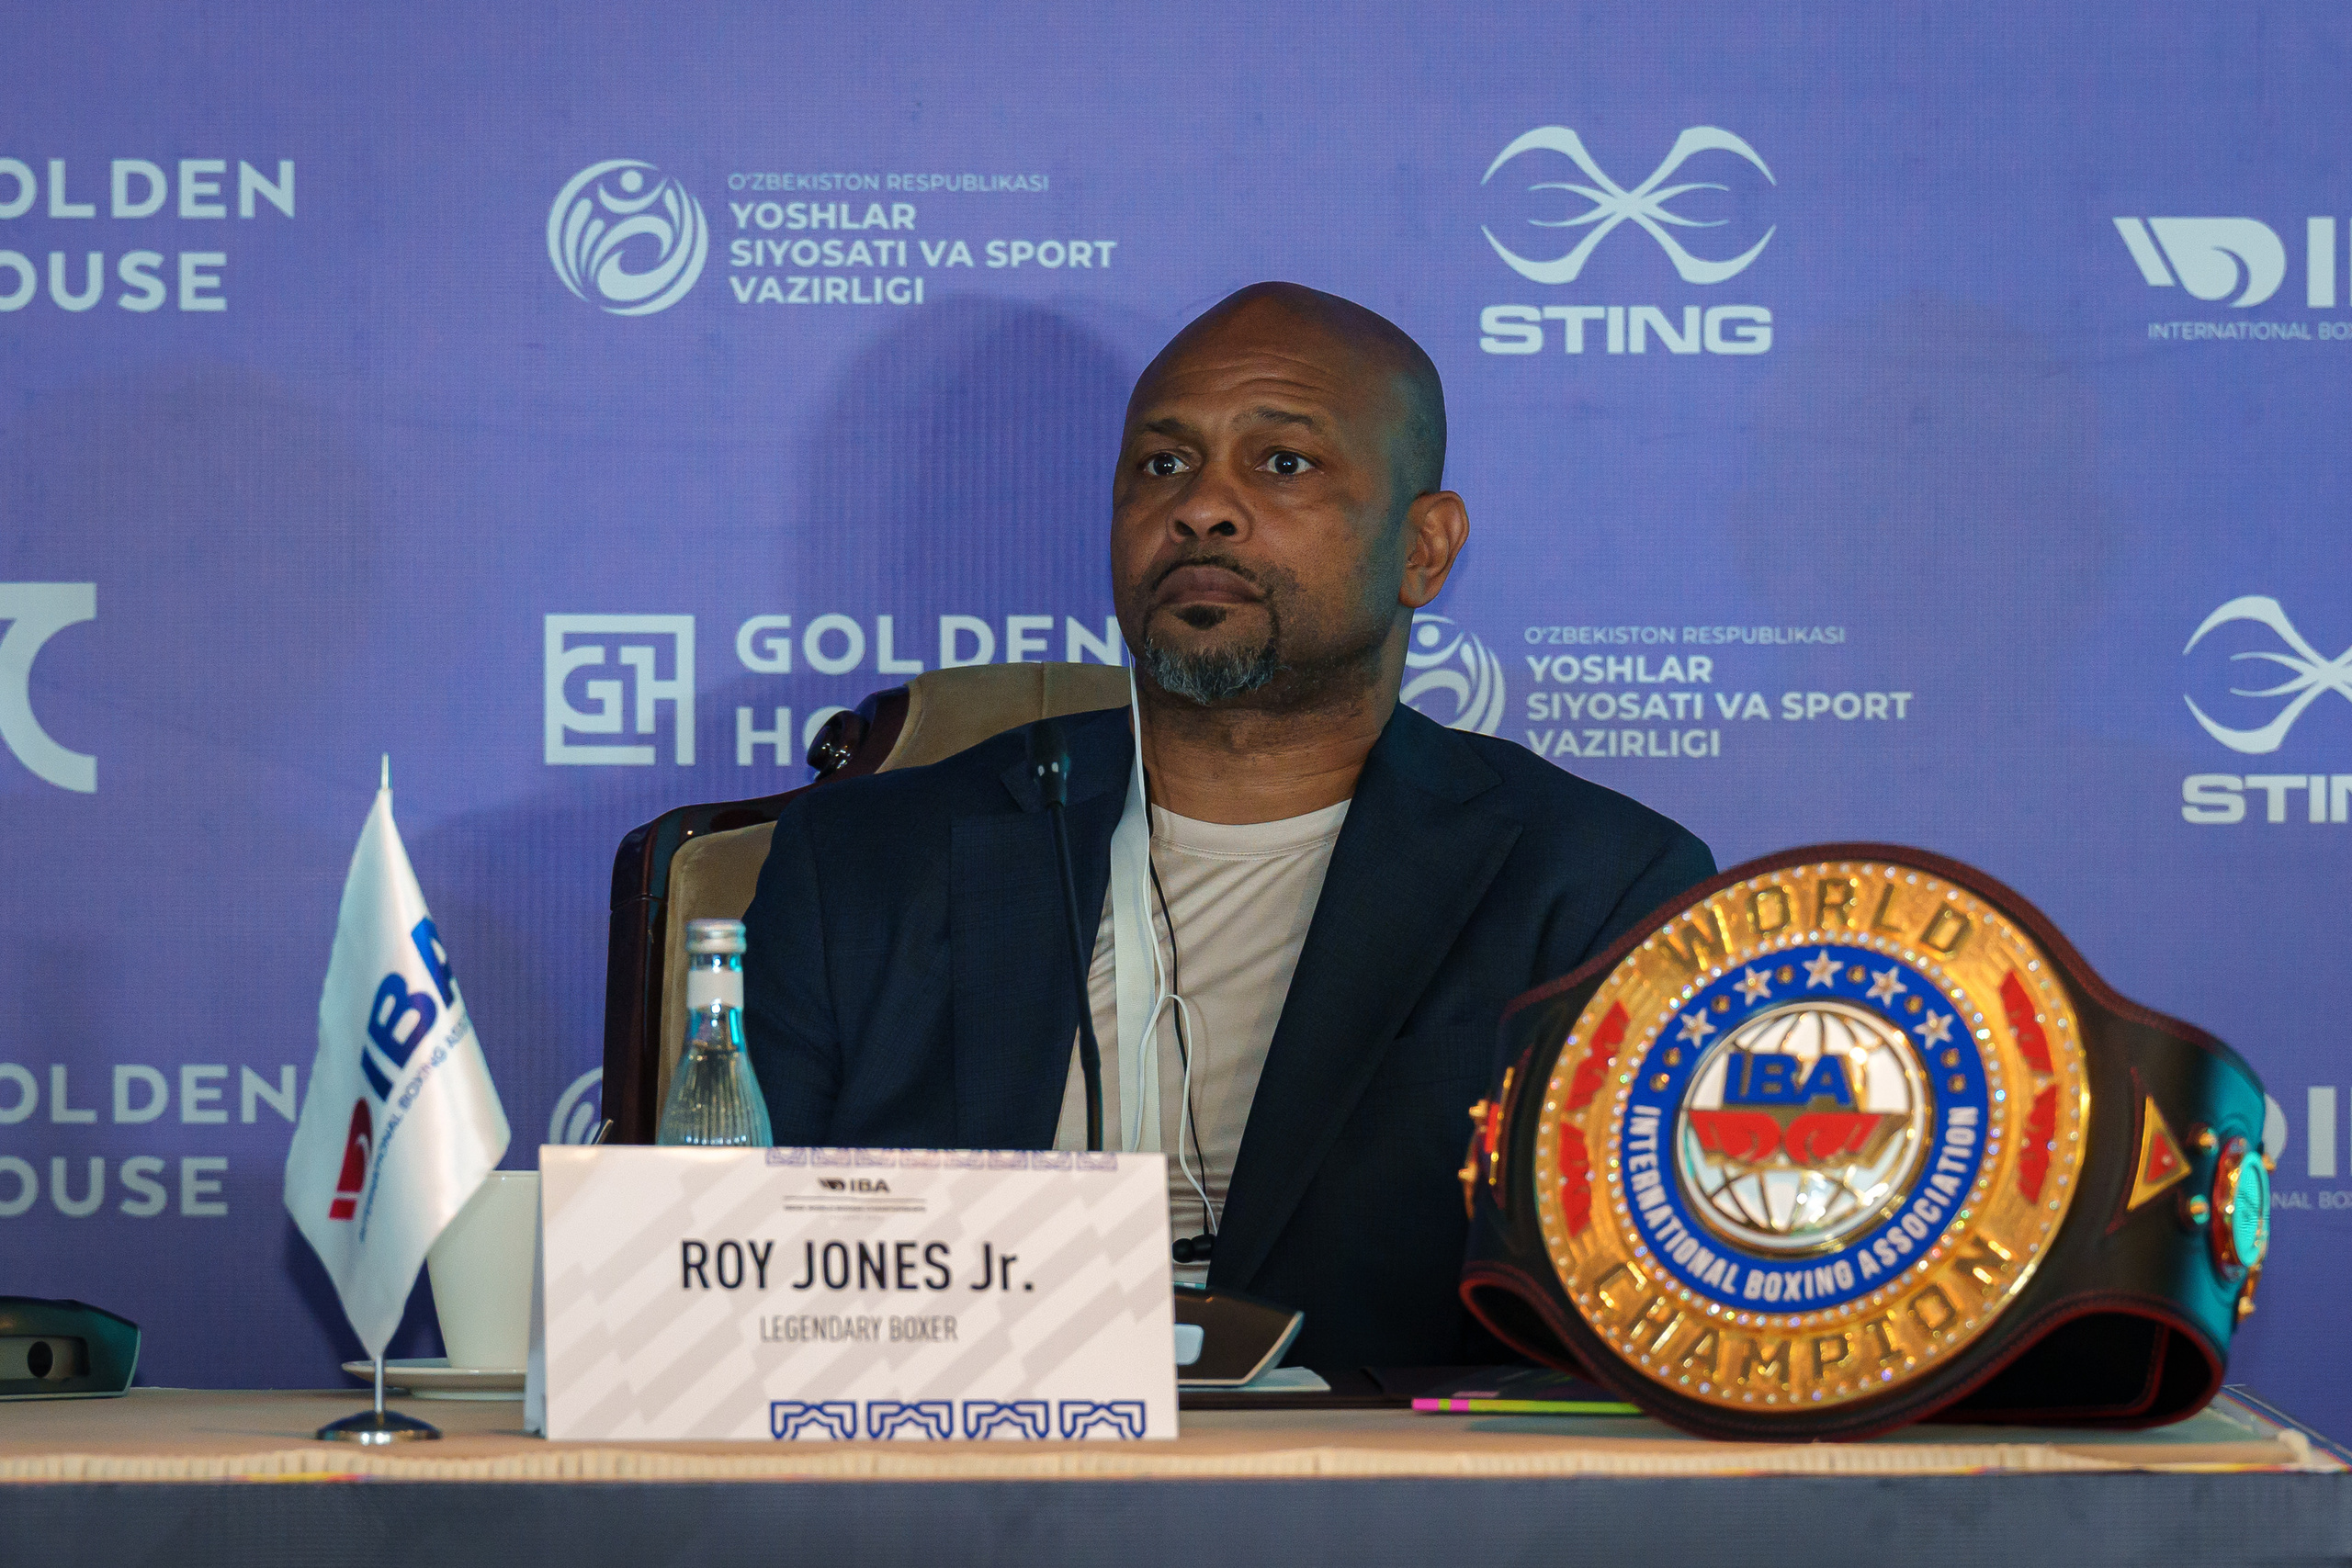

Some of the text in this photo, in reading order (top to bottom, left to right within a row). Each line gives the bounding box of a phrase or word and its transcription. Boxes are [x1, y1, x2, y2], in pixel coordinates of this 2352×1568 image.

[886, 173, 1049, 193] RESPUBLIKASI
[729, 202, 917, 231] YOSHLAR
[730, 239, 1117, 269] SIYOSATI VA SPORT
[729, 276, 924, 305] VAZIRLIGI
[1480, 305, 1772, 355] STING
[2147, 321, 2352, 341] INTERNATIONAL BO
[736, 615, 1123, 673] GOLDEN
[1682, 626, 1846, 646] RESPUBLIKASI
[1526, 655, 1713, 683] YOSHLAR
[1527, 692, 1913, 720] SIYOSATI VA SPORT
[1526, 728, 1722, 759] VAZIRLIGI
[1659, 877, 1973, 971] WORLD
[1724, 1052, 1854, 1106] IBA
[848, 1178, 891, 1194] IBA
[1627, 1105, 1979, 1303] INTERNATIONAL BOXING ASSOCIATION
[681, 1240, 1035, 1292] ROY JONES Jr.
[1596, 1233, 2014, 1383] CHAMPION
[759, 1314, 958, 1344] LEGENDARY BOXER
